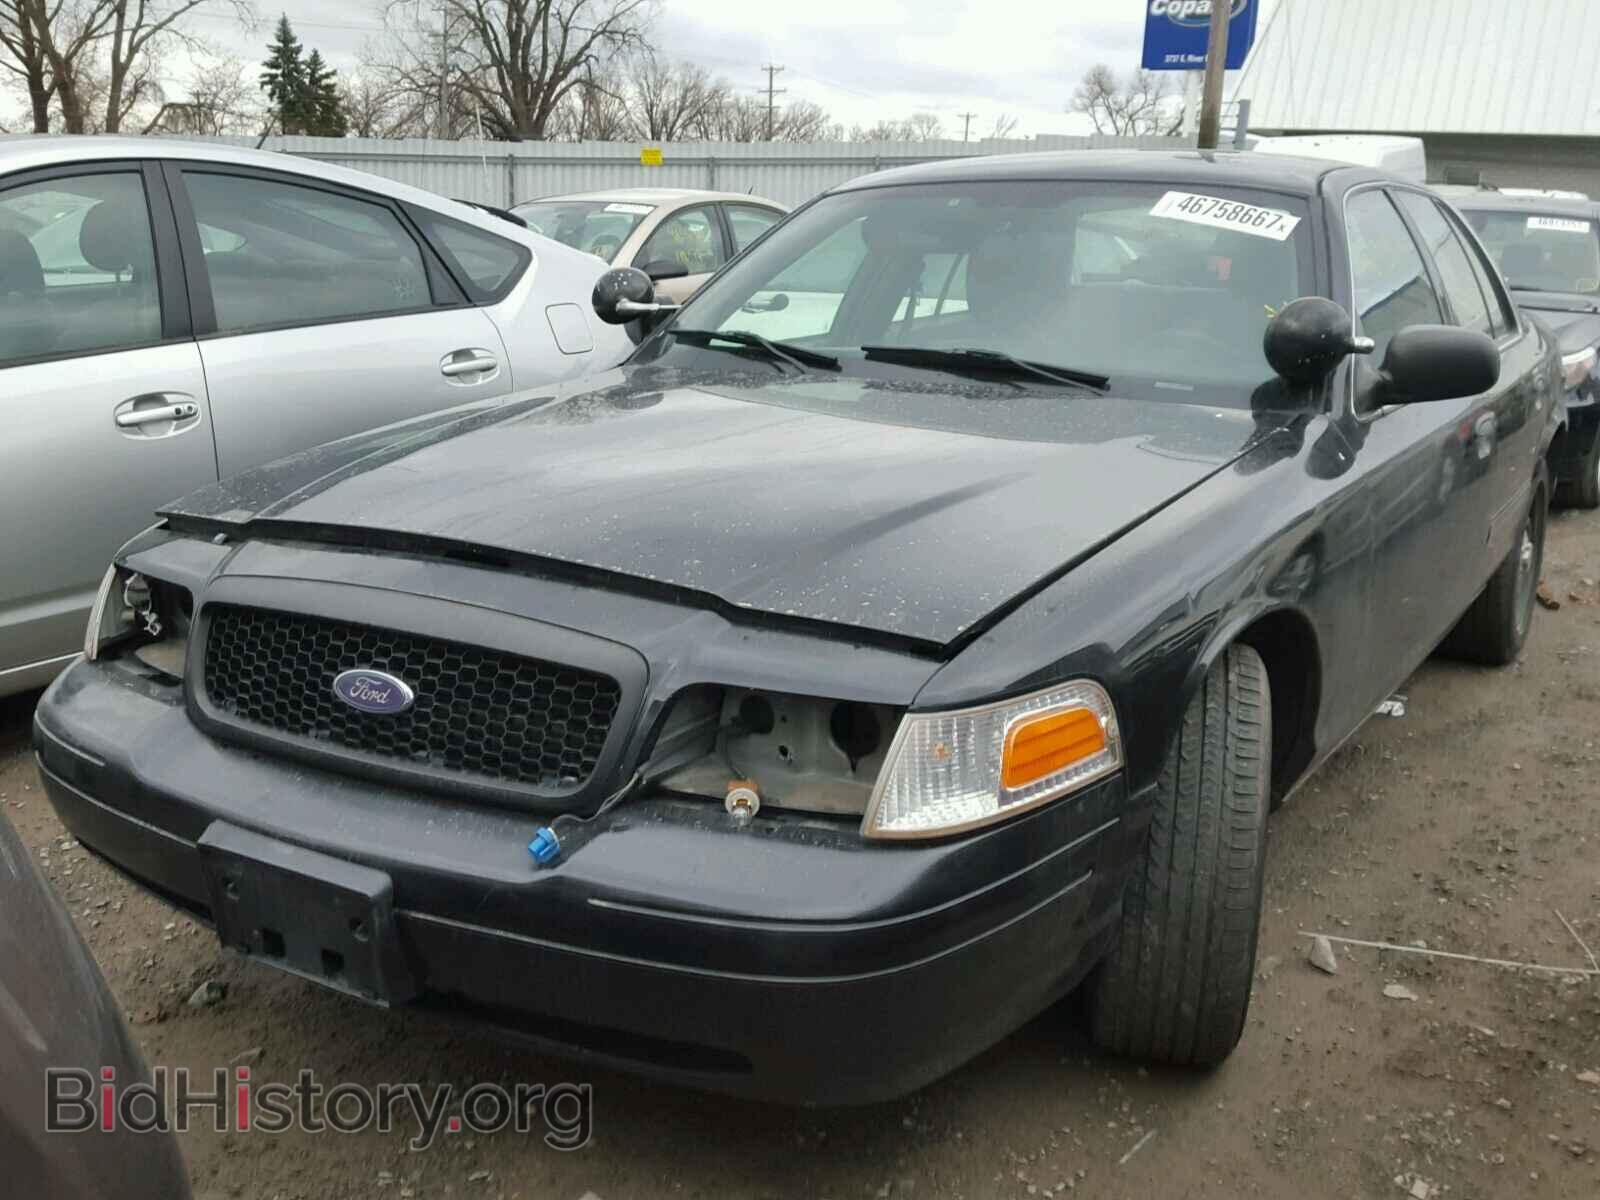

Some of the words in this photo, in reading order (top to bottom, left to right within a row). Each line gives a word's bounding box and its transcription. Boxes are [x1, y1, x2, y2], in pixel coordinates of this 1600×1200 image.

[1150, 0, 1214, 20] Copa
[1178, 195, 1283, 229] 46758667
[350, 677, 393, 704] Ford
